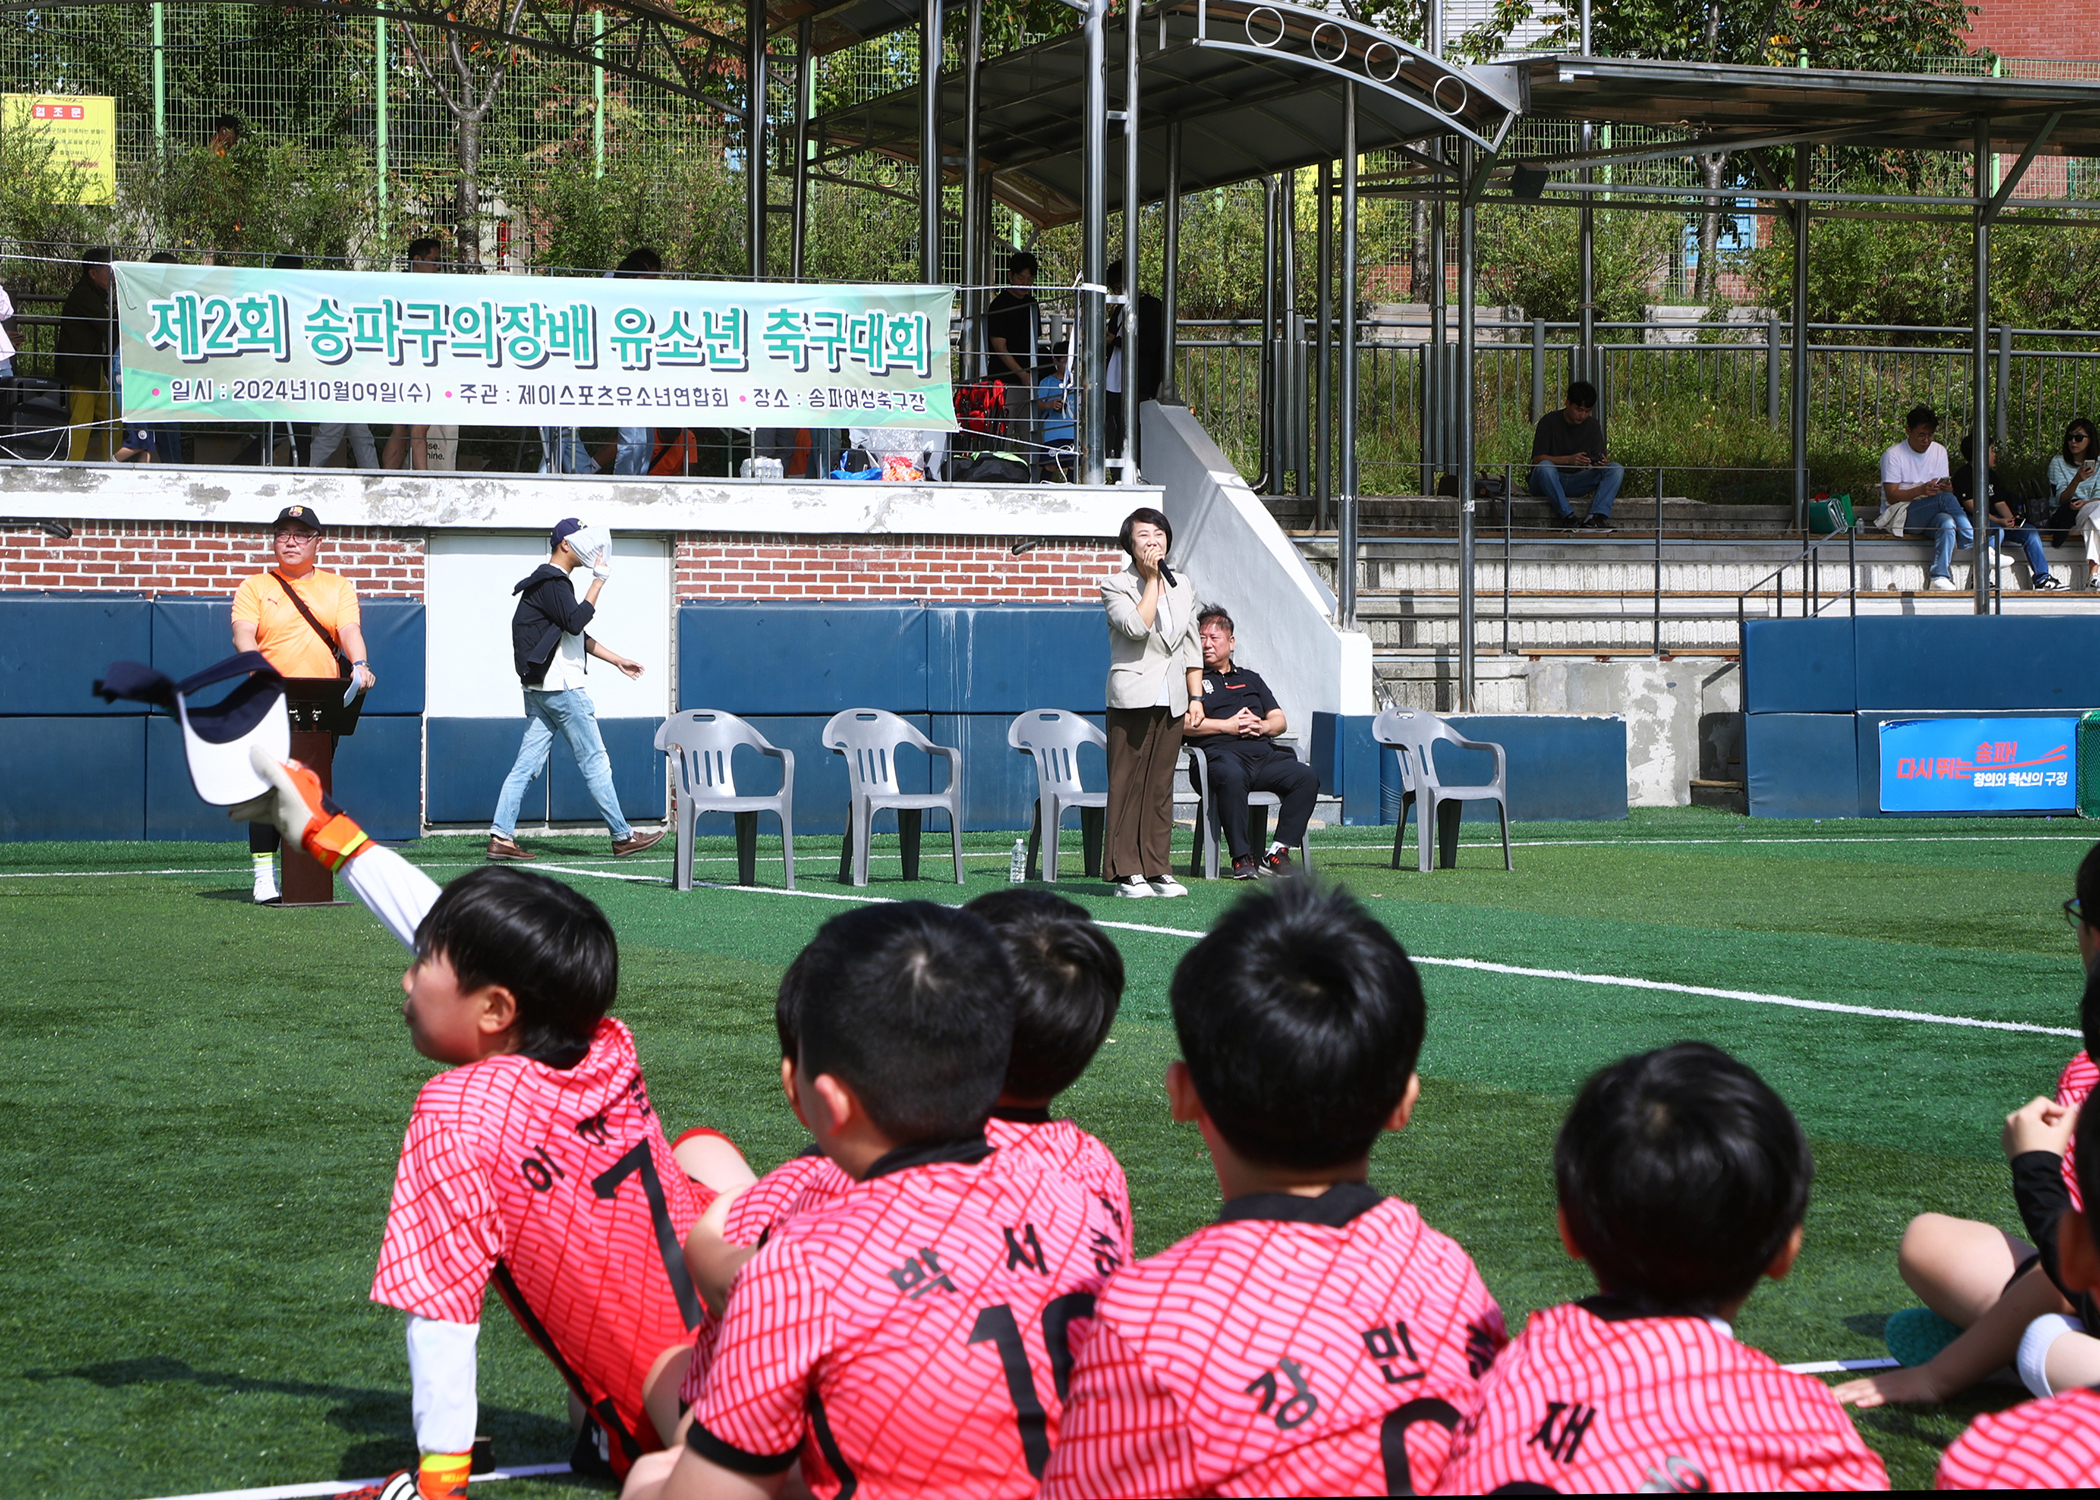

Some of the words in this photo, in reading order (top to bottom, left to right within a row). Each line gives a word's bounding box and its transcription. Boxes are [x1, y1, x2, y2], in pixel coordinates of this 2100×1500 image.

[149, 292, 286, 360] 제2회
[302, 296, 594, 367] 송파구의장배
[607, 304, 744, 370] 유소년
[760, 303, 928, 374] 축구대회
[171, 379, 213, 401] 일시
[233, 380, 432, 403] 2024년10월09일(수)
[459, 383, 499, 404] 주관
[517, 384, 729, 407] 제이스포츠유소년연합회
[753, 387, 791, 408] 장소
[808, 387, 926, 412] 송파여성축구장
[427, 442, 440, 450] se.
[1896, 757, 1933, 780] 다시
[1935, 757, 1973, 780] 뛰는
[1975, 741, 2018, 763] 송파!
[1973, 772, 2007, 787] 창의와
[2008, 772, 2044, 787] 혁신의
[2044, 771, 2069, 787] 구정
[520, 1144, 566, 1194] 이
[590, 1136, 704, 1334] 7
[887, 1247, 960, 1301] 박
[1003, 1223, 1050, 1277] 서
[1244, 1356, 1319, 1430] 강
[1361, 1320, 1427, 1385] 민
[1526, 1401, 1598, 1464] 재
